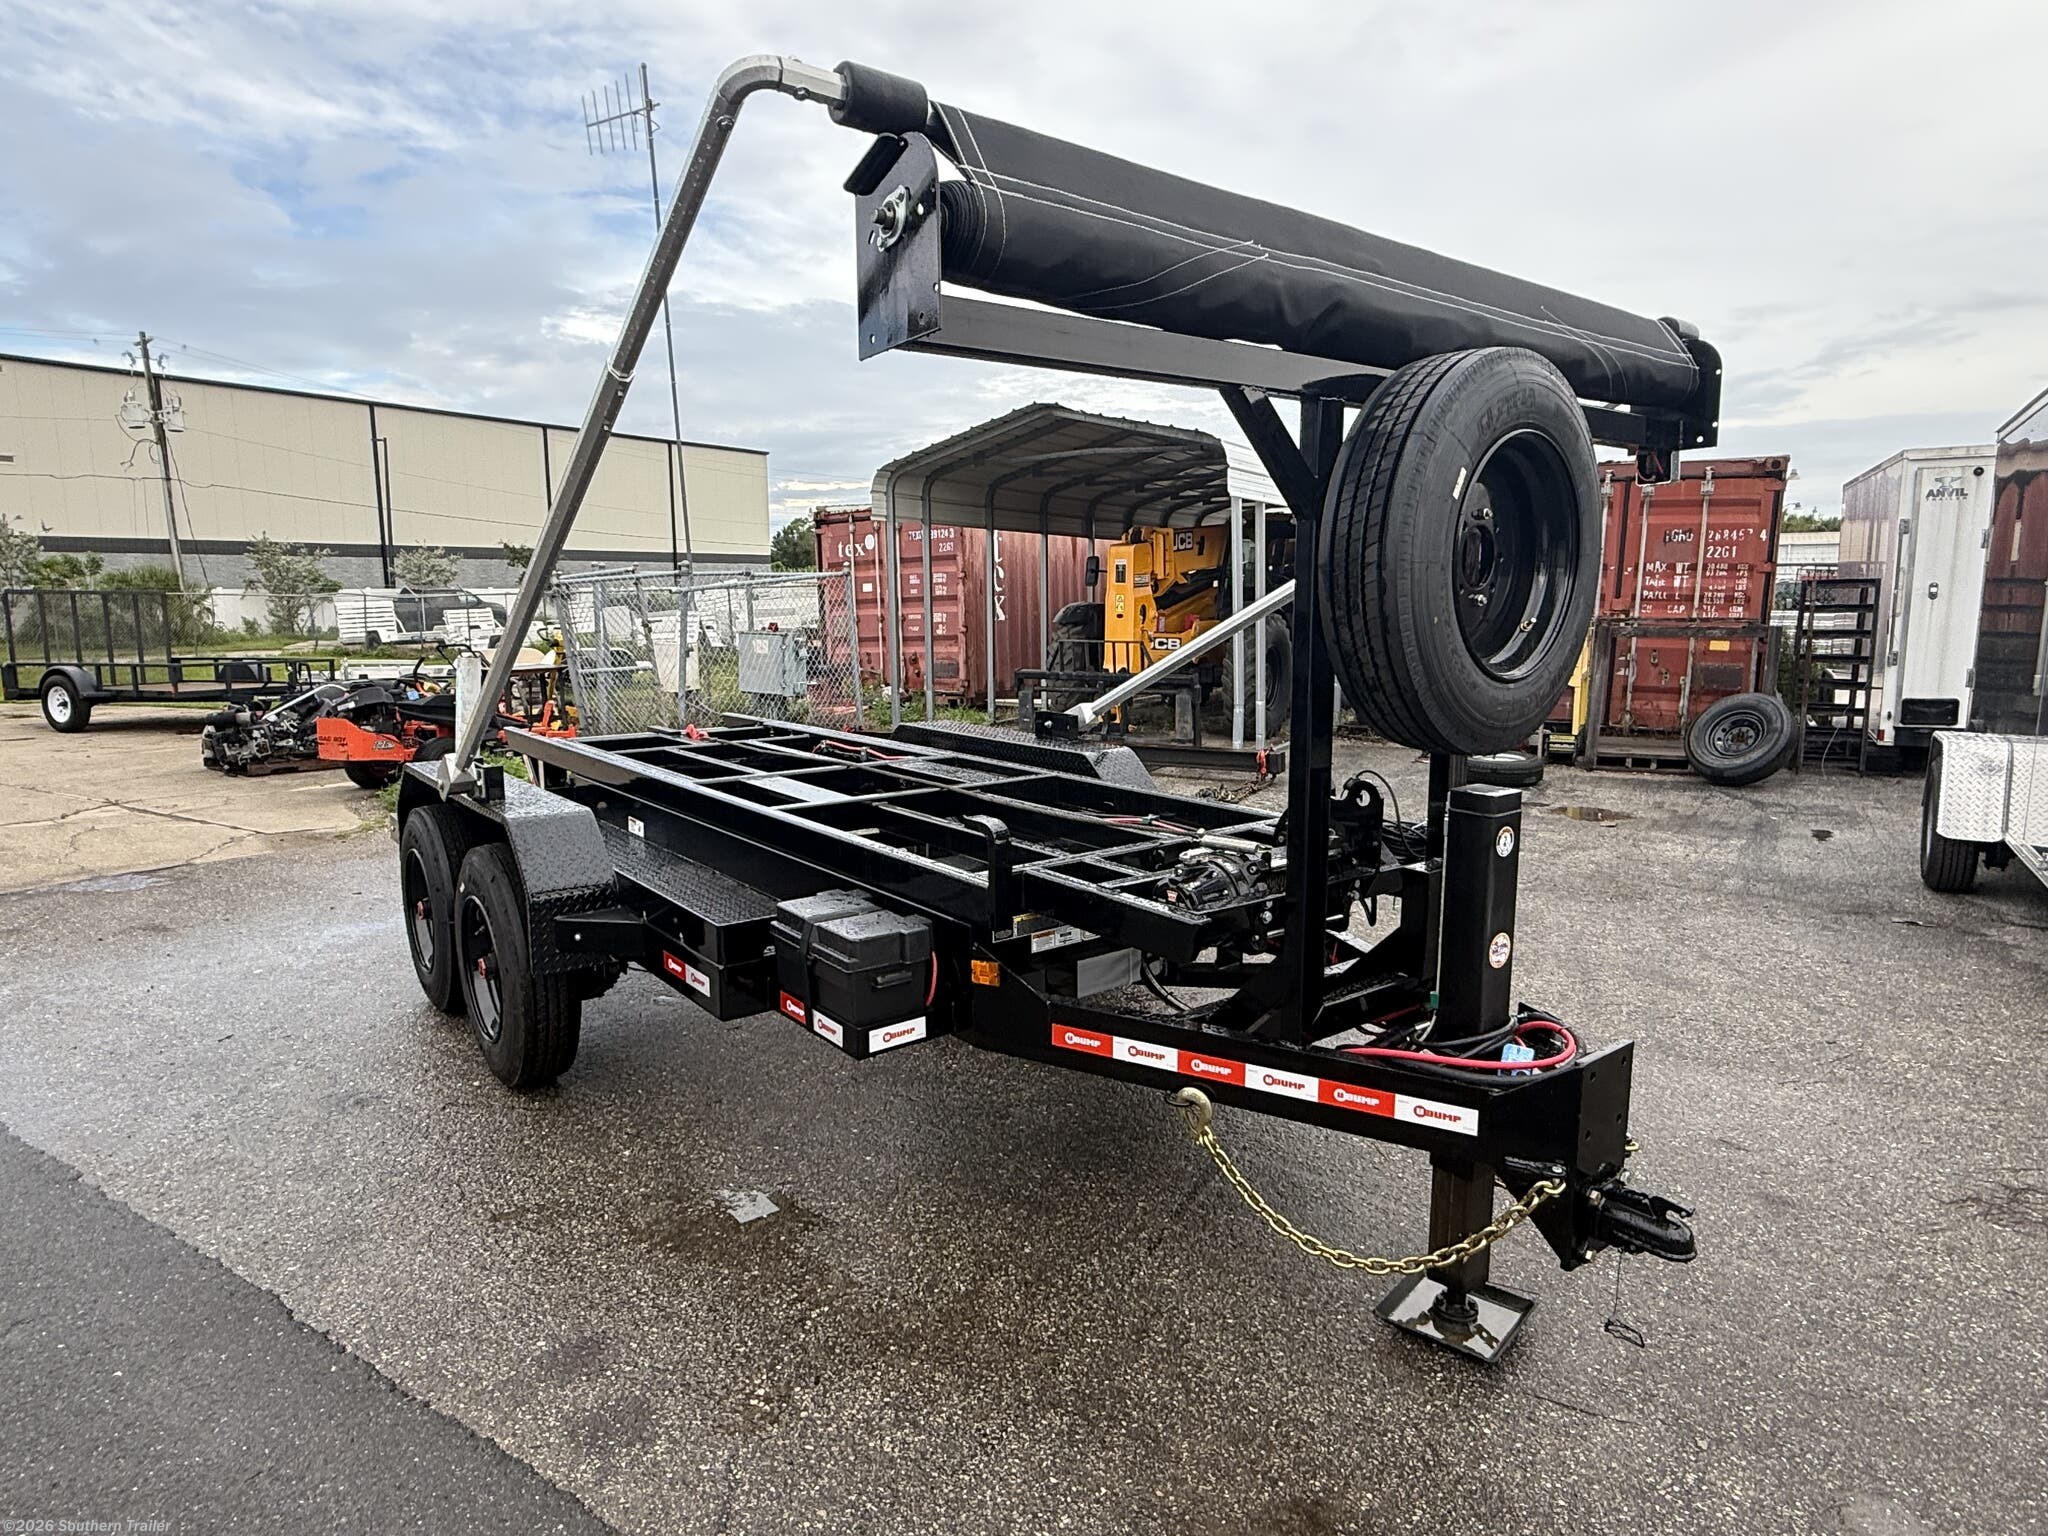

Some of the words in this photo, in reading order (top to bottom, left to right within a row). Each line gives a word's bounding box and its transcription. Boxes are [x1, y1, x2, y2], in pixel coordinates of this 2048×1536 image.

[1926, 487, 1968, 499] ANVIL
[1173, 532, 1193, 551] JCB
[1705, 546, 1737, 558] 22G1
